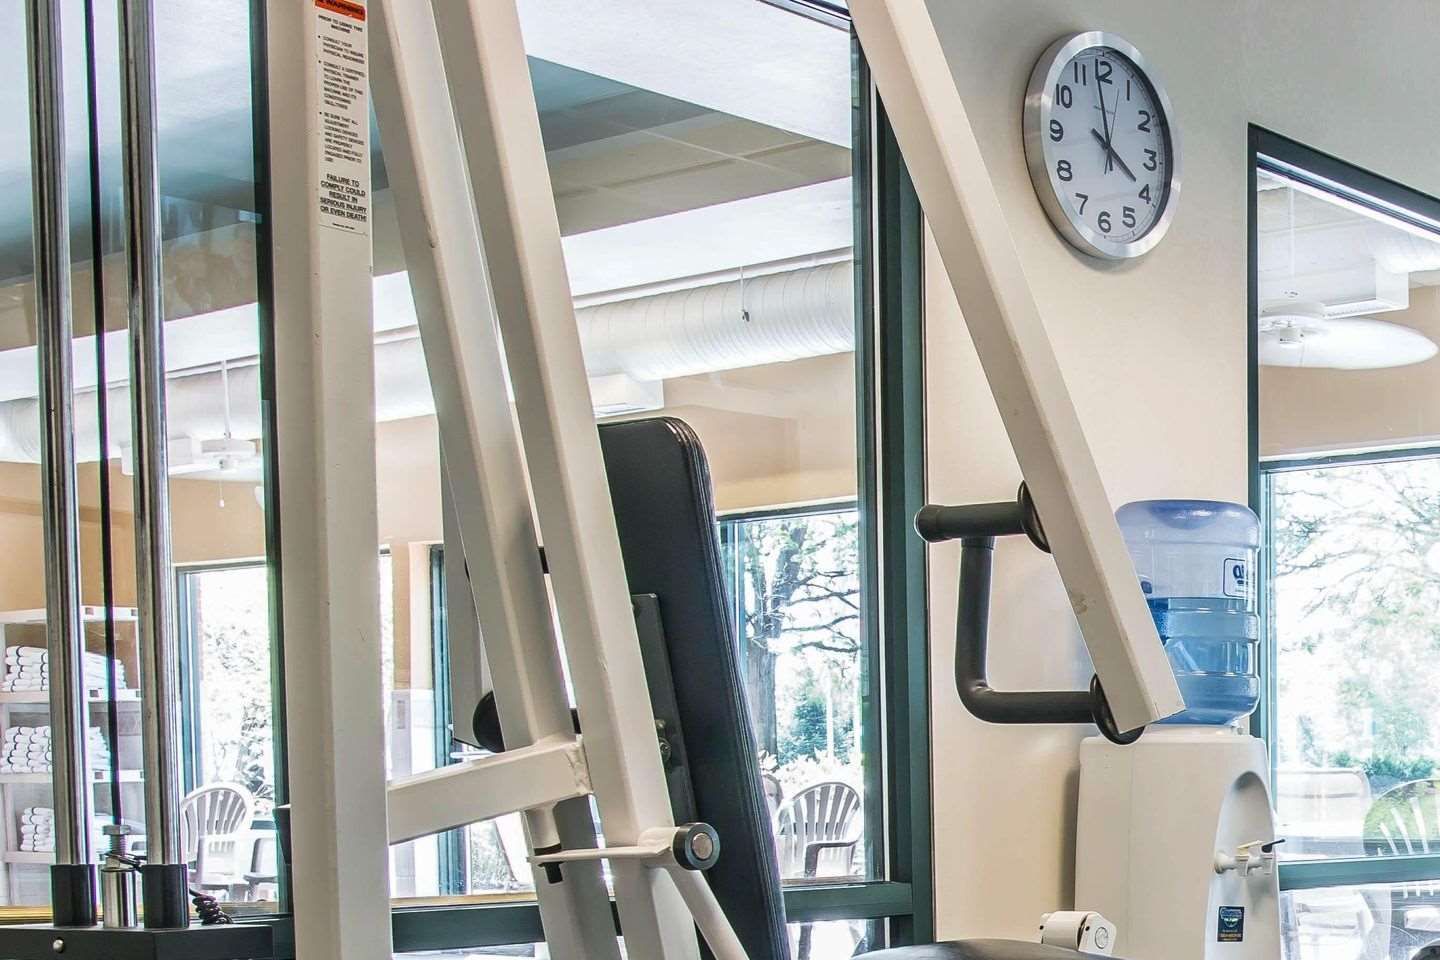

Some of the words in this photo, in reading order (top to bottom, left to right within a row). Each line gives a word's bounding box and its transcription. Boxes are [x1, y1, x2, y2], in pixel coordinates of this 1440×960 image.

[1073, 61, 1087, 86] 11
[1056, 84, 1072, 109] 10
[1127, 80, 1131, 101] 1
[1050, 120, 1064, 142] 9
[1138, 111, 1151, 133] 2
[1143, 149, 1157, 171] 3
[327, 173, 350, 185] FAILURE
[352, 180, 359, 188] TO
[1057, 160, 1073, 182] 8
[321, 180, 344, 192] COMPLY
[346, 186, 365, 197] COULD
[329, 191, 349, 202] RESULT
[352, 196, 357, 204] IN
[1138, 184, 1151, 204] 4
[320, 197, 345, 210] SERIOUS
[347, 203, 367, 215] INJURY
[320, 205, 328, 213] OR
[331, 208, 345, 218] EVEN
[1075, 193, 1088, 215] 7
[1097, 211, 1111, 233] 6
[1122, 207, 1136, 228] 5
